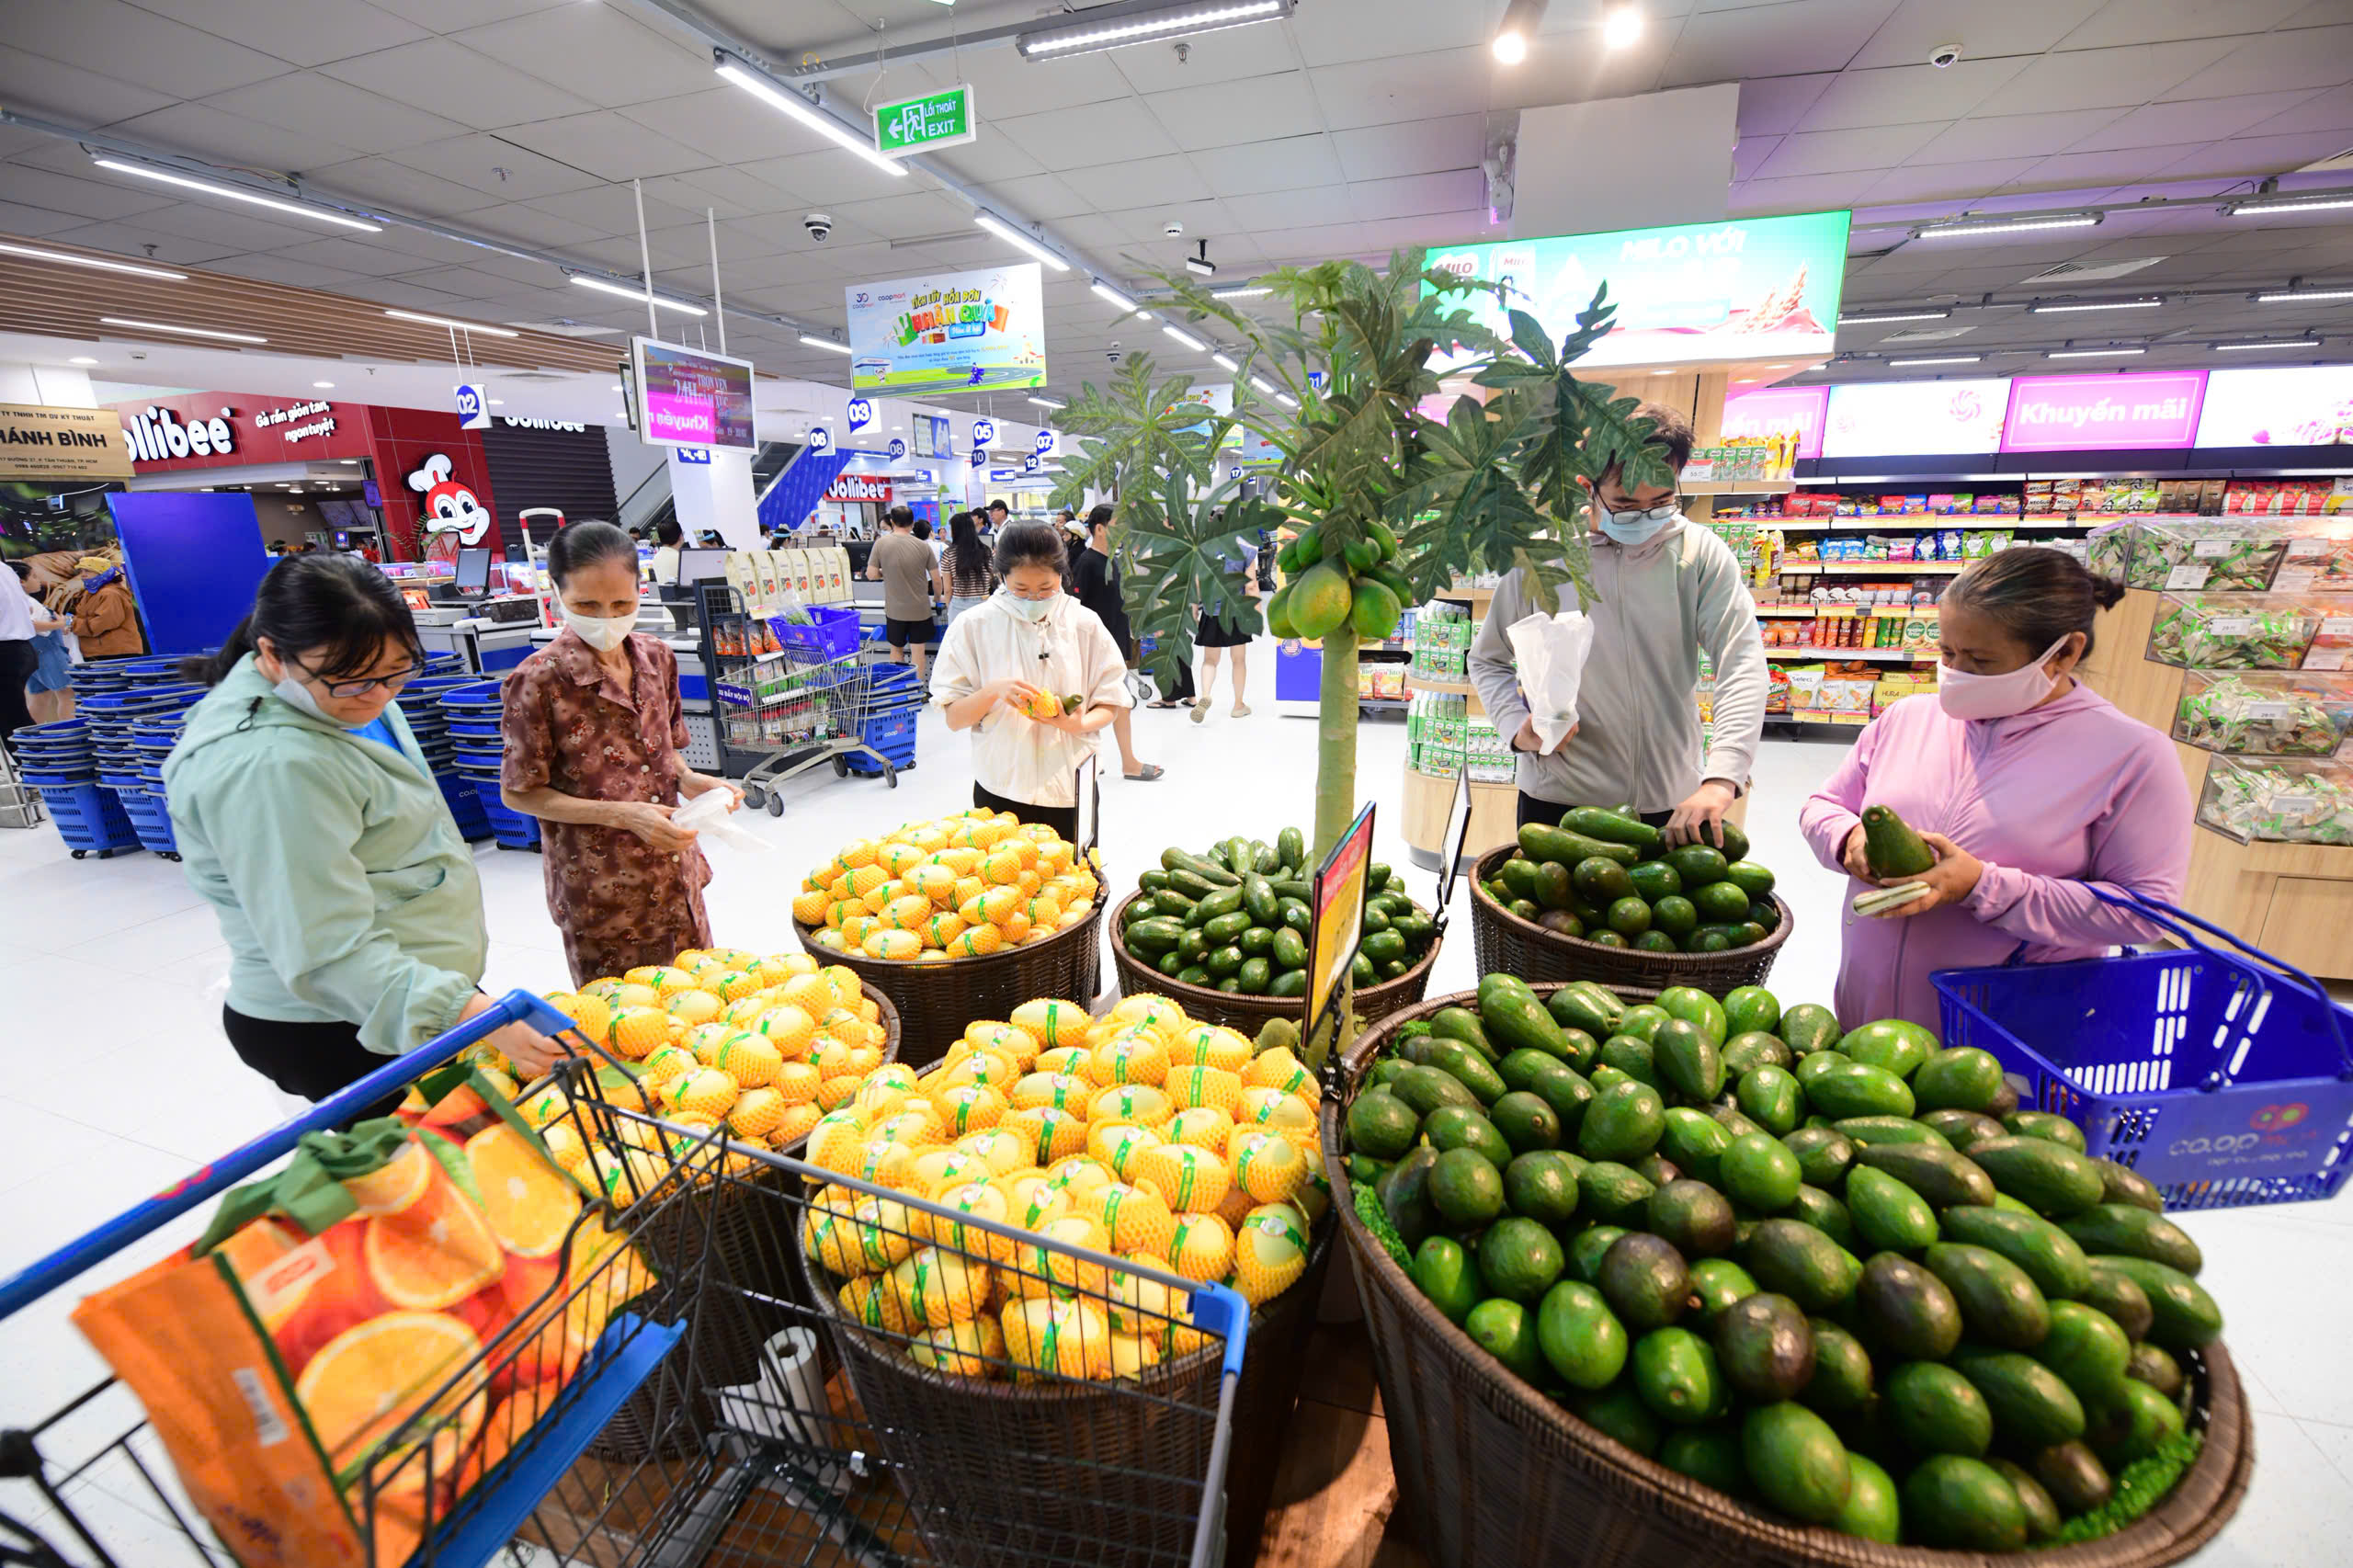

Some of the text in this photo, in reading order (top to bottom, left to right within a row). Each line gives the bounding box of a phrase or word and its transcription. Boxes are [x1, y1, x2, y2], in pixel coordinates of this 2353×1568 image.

[936, 99, 957, 115] THOÁT
[927, 119, 955, 137] EXIT
[1438, 261, 1472, 275] MILO
[457, 393, 478, 415] 02
[2019, 396, 2188, 429] Khuyến mãi
[256, 410, 273, 428] Gà
[289, 402, 310, 423] giòn
[310, 401, 330, 416] tan,
[848, 403, 870, 423] 03
[57, 429, 108, 448] BÌNH
[123, 406, 232, 462] ollibee
[284, 417, 335, 443] ngon tuyệt
[973, 425, 993, 440] 05
[810, 432, 827, 447] 06
[1037, 436, 1051, 449] 07
[889, 443, 904, 456] 08
[972, 451, 984, 463] 10
[1026, 458, 1037, 468] 12
[1231, 469, 1241, 478] 17
[828, 475, 886, 499] Jollibee
